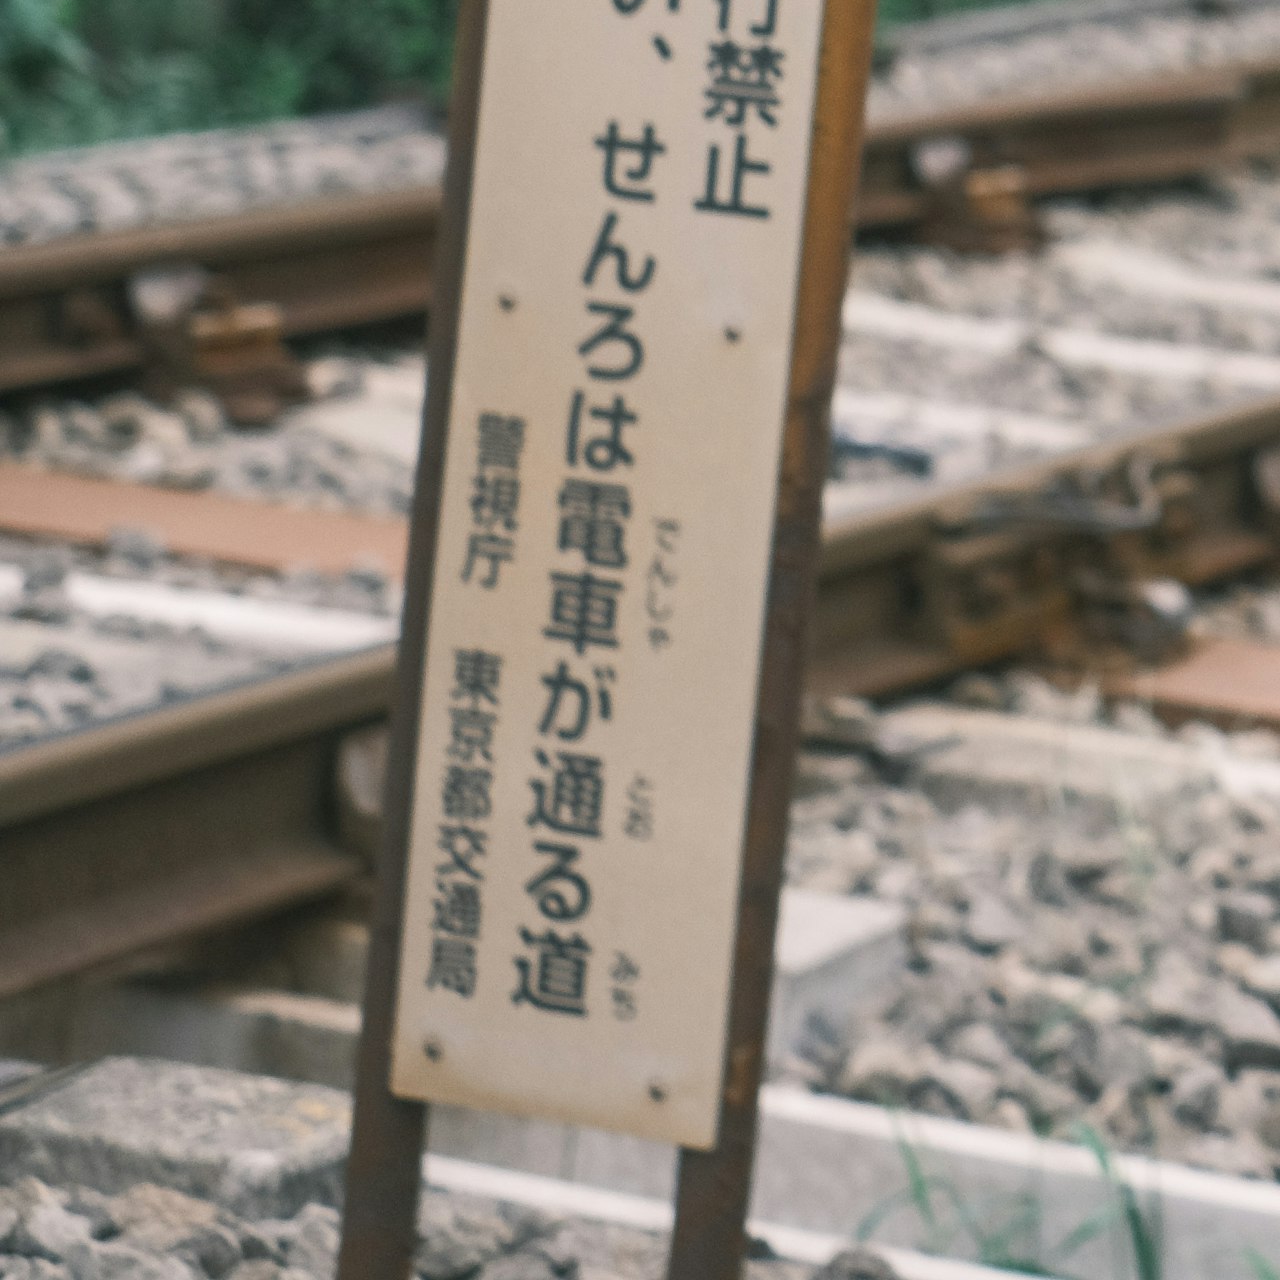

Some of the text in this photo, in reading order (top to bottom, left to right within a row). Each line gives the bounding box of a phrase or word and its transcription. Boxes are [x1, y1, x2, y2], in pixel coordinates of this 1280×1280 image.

[423, 409, 530, 1002] 警視庁 東京都交通局
